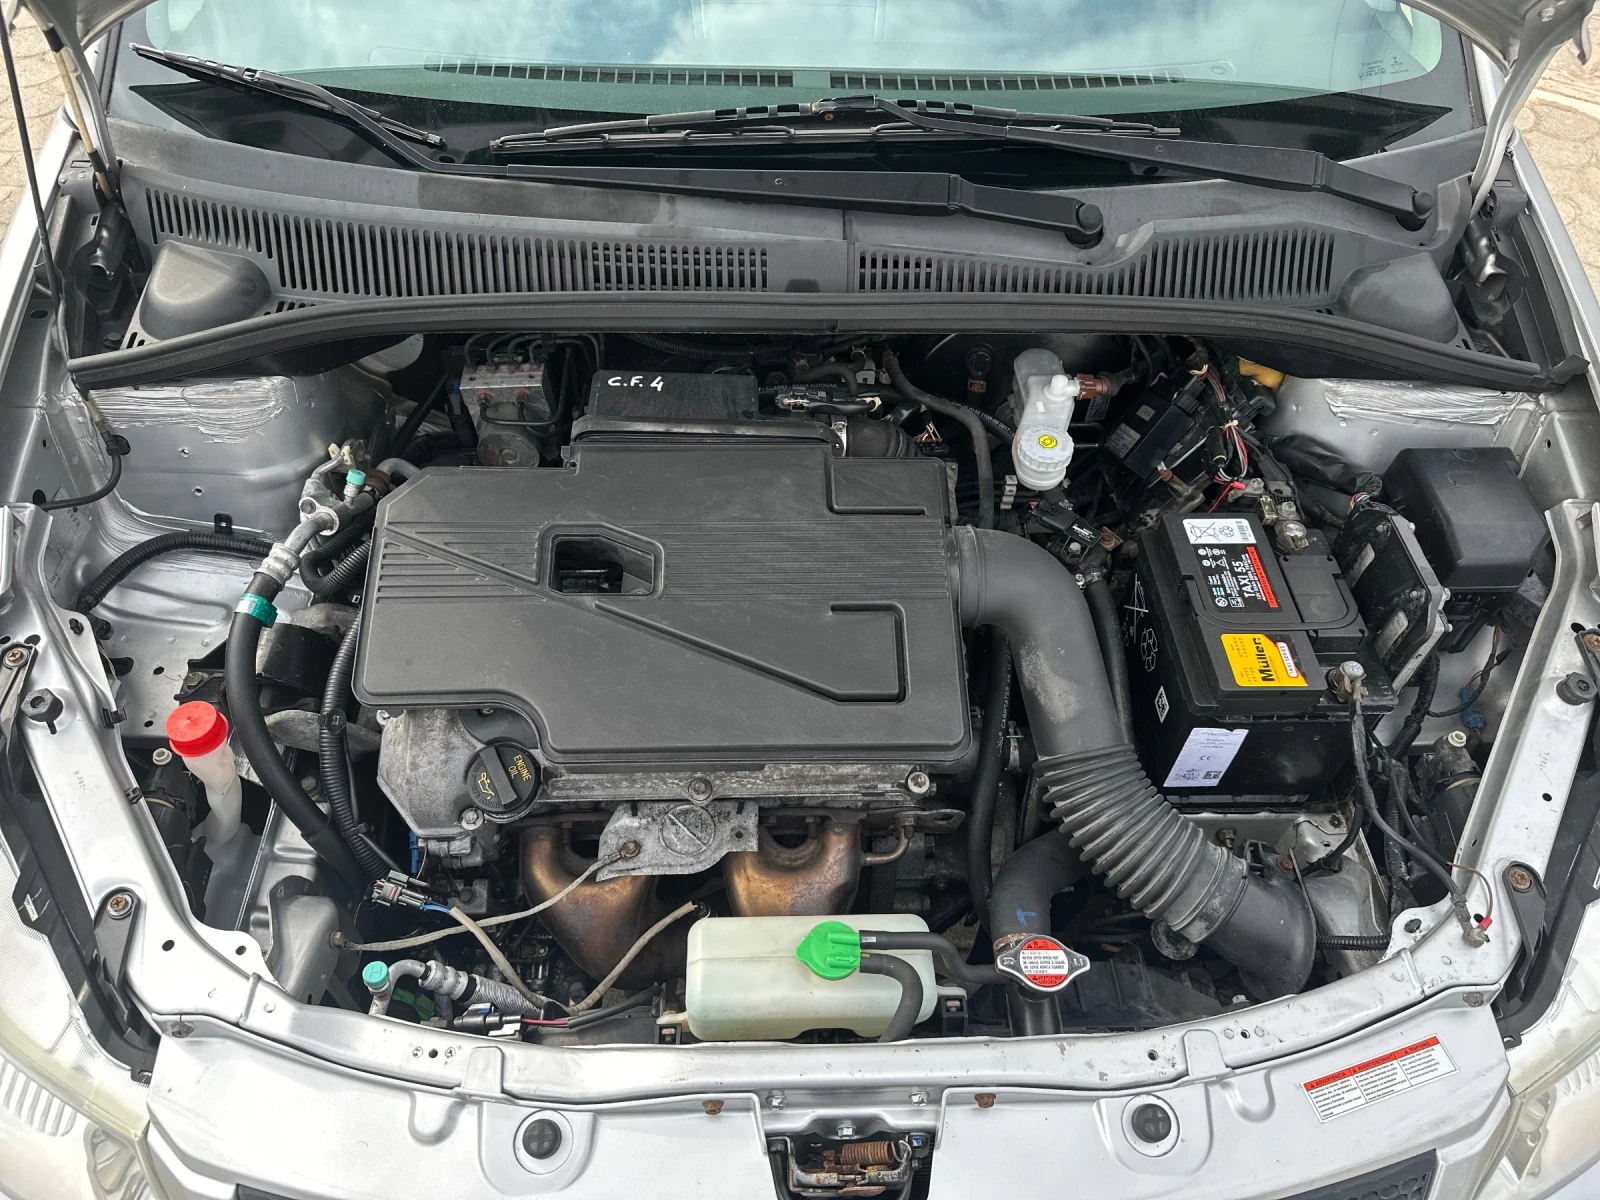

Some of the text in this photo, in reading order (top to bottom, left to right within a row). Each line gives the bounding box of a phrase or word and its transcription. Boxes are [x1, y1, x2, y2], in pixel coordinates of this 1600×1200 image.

[650, 376, 664, 391] 4
[1232, 560, 1246, 573] 55
[1237, 575, 1257, 597] TAXI
[508, 765, 519, 780] OIL
[513, 754, 532, 782] ENGINE
[369, 964, 383, 979] H
